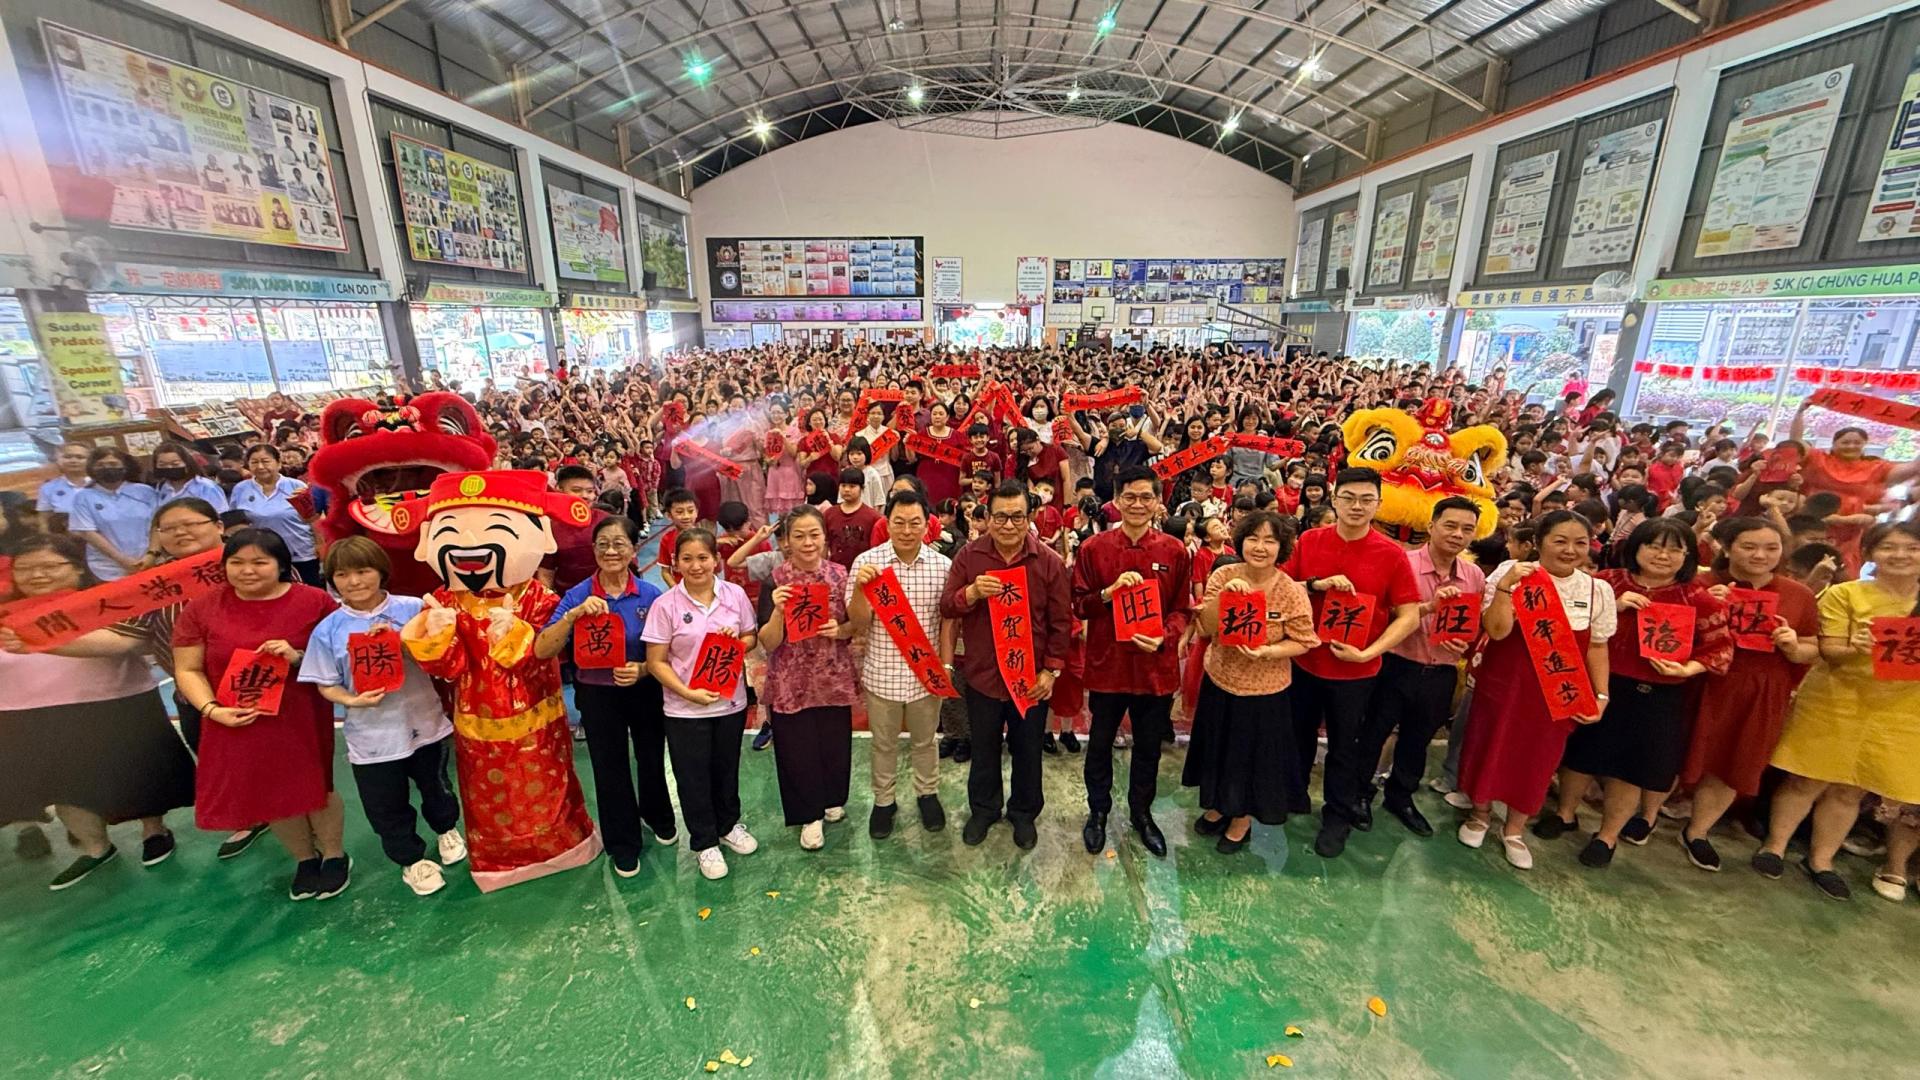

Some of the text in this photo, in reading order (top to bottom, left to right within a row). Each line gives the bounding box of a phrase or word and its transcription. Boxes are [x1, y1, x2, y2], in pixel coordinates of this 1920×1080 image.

[337, 283, 355, 294] CAN
[356, 284, 369, 295] DO
[371, 285, 377, 295] IT
[1532, 288, 1593, 303] 自强不息
[1772, 271, 1920, 291] SJK (C) CHUNG HUA P
[48, 322, 99, 332] Sudut
[50, 337, 105, 346] Pidato
[60, 366, 112, 376] Speaker
[69, 380, 112, 389] Corner
[788, 587, 823, 633] 春
[1120, 586, 1159, 625] 旺
[1221, 601, 1264, 642] 瑞
[1321, 600, 1366, 642] 祥
[1436, 604, 1474, 634] 旺
[580, 620, 613, 657] 萬
[997, 581, 1028, 696] 恭賀新禧
[1522, 585, 1579, 707] 新年進步
[1643, 616, 1682, 654] 福
[353, 641, 399, 676] 勝
[695, 645, 739, 685] 勝
[230, 662, 280, 709] 豐
